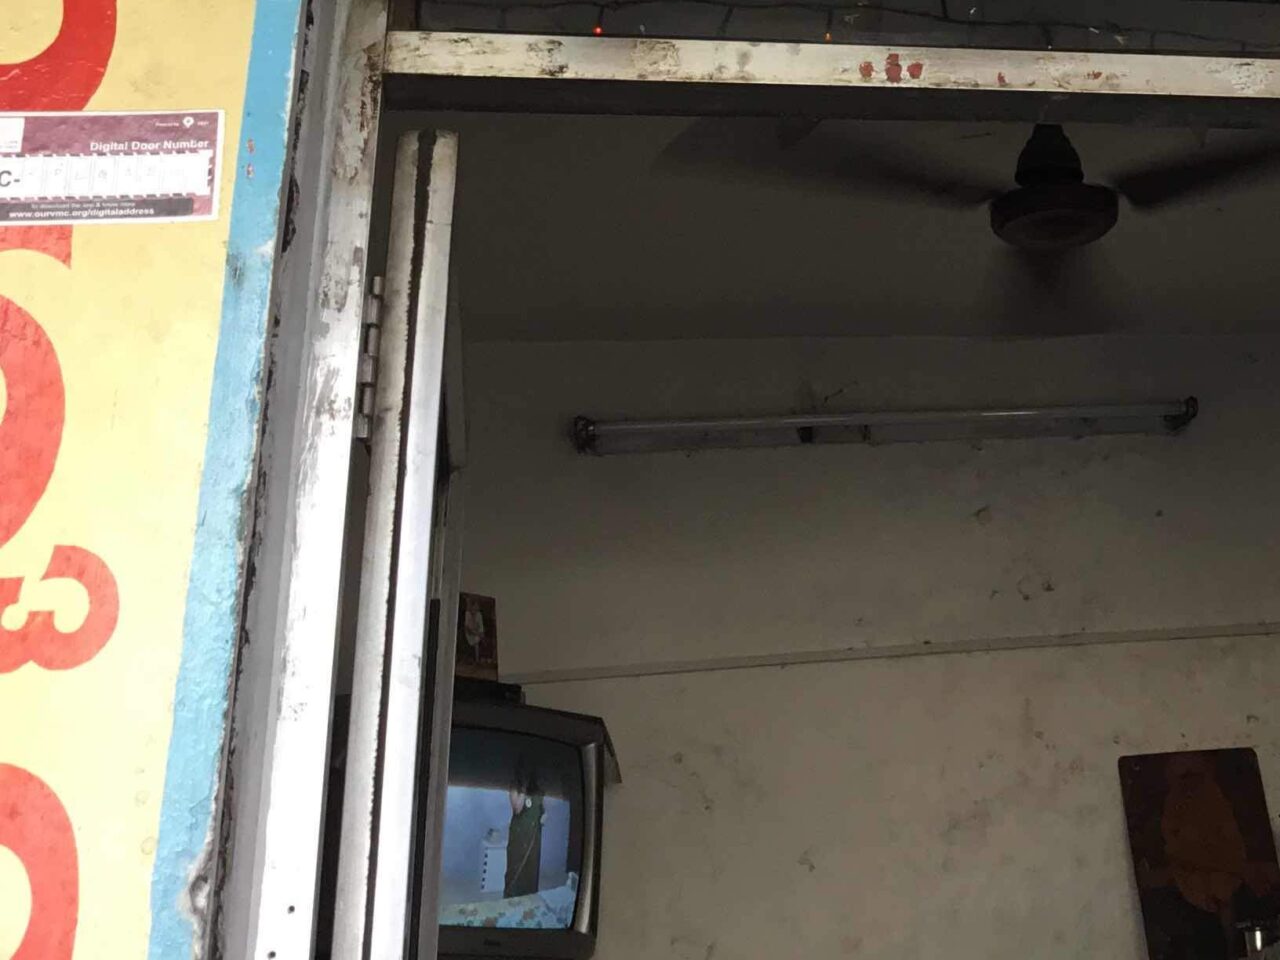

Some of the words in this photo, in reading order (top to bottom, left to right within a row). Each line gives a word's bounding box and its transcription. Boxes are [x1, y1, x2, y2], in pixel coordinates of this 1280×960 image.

[89, 141, 129, 153] Digital
[131, 140, 160, 151] Door
[163, 139, 209, 150] Number
